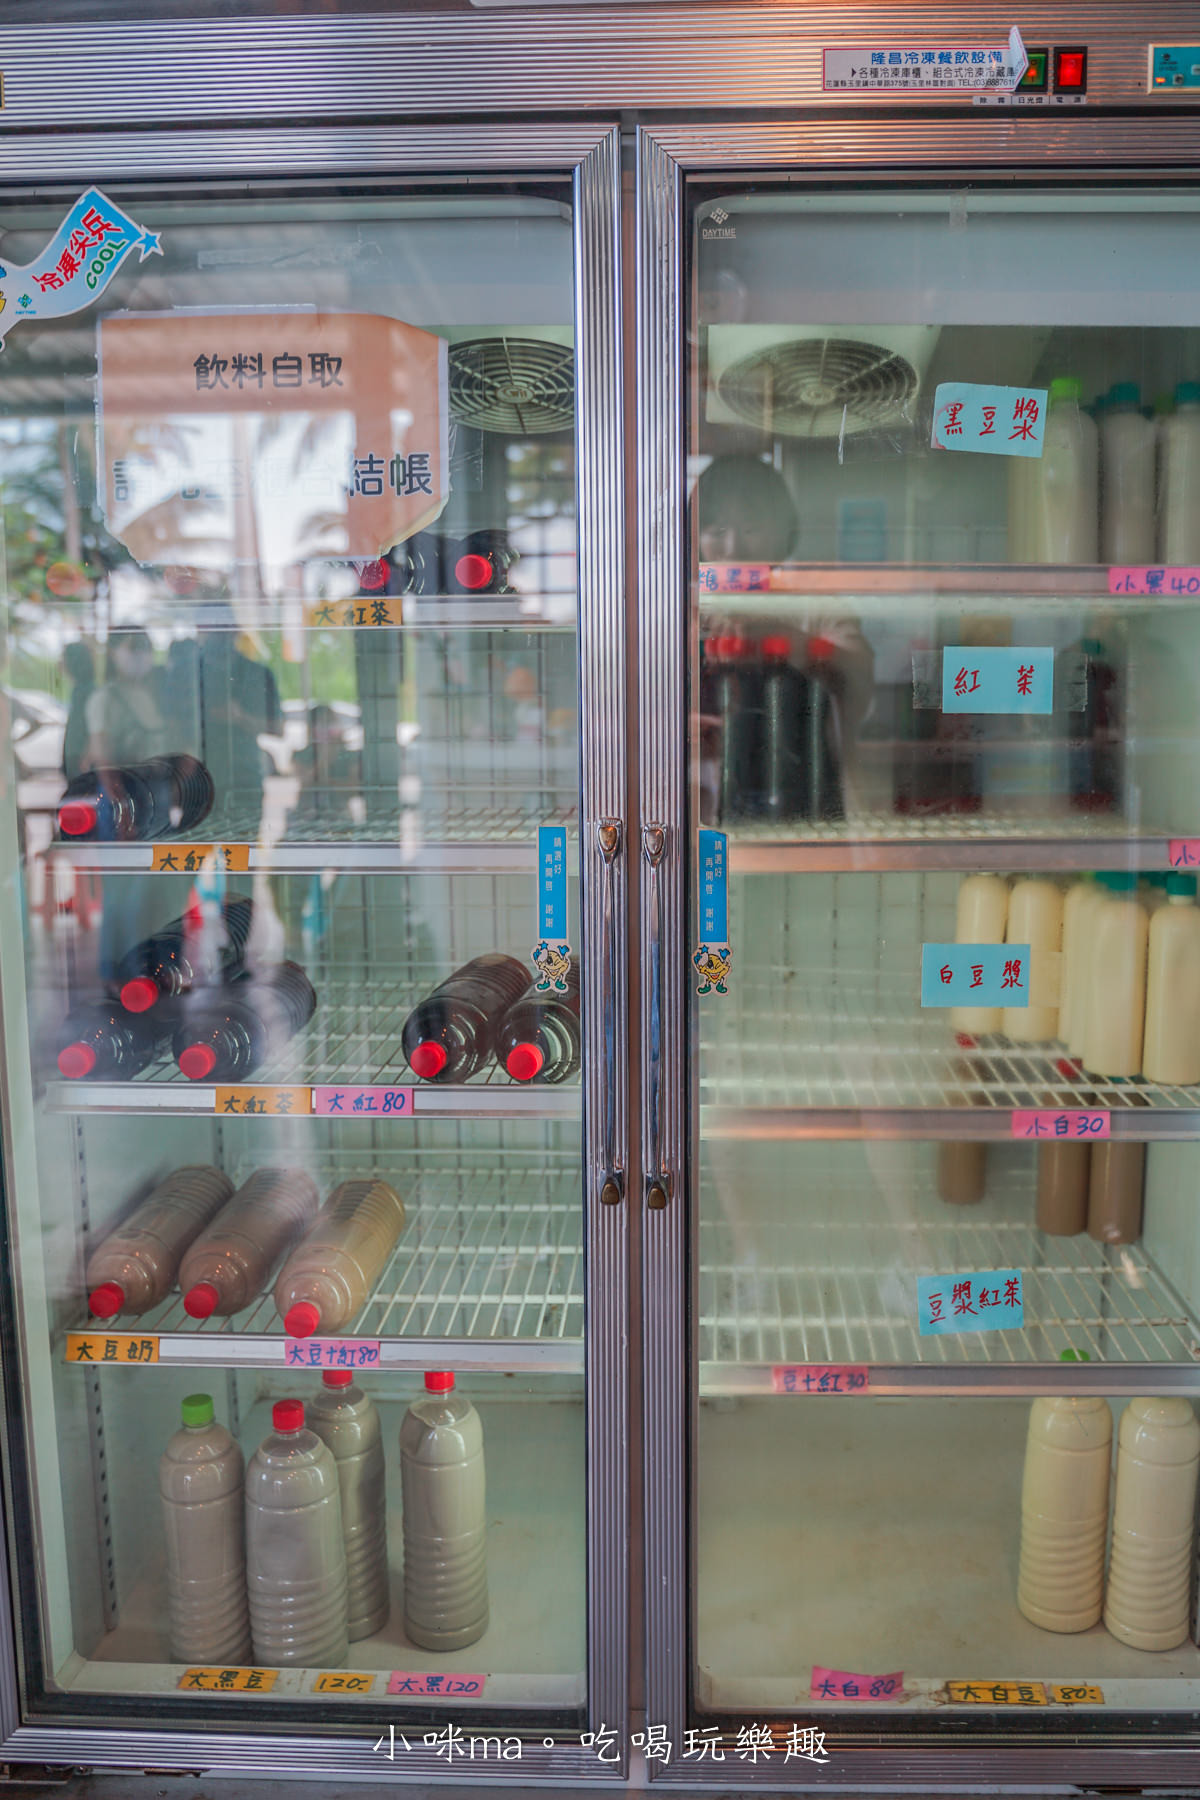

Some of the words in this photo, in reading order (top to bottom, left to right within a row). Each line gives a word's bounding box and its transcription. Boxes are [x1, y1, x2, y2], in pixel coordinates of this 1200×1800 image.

[871, 51, 1003, 65] 隆昌冷凍餐飲設備
[703, 228, 736, 238] DAYTIME
[32, 207, 122, 292] 冷凍尖兵
[86, 240, 127, 289] COOL
[194, 353, 343, 389] 飲料自取
[944, 397, 1039, 440] 黑豆漿
[315, 601, 394, 625] 大紅茶
[940, 959, 1024, 989] 白豆漿
[224, 1092, 292, 1113] 大紅茶
[928, 1277, 1022, 1324] 豆漿紅茶
[189, 1671, 265, 1689] 大黑豆
